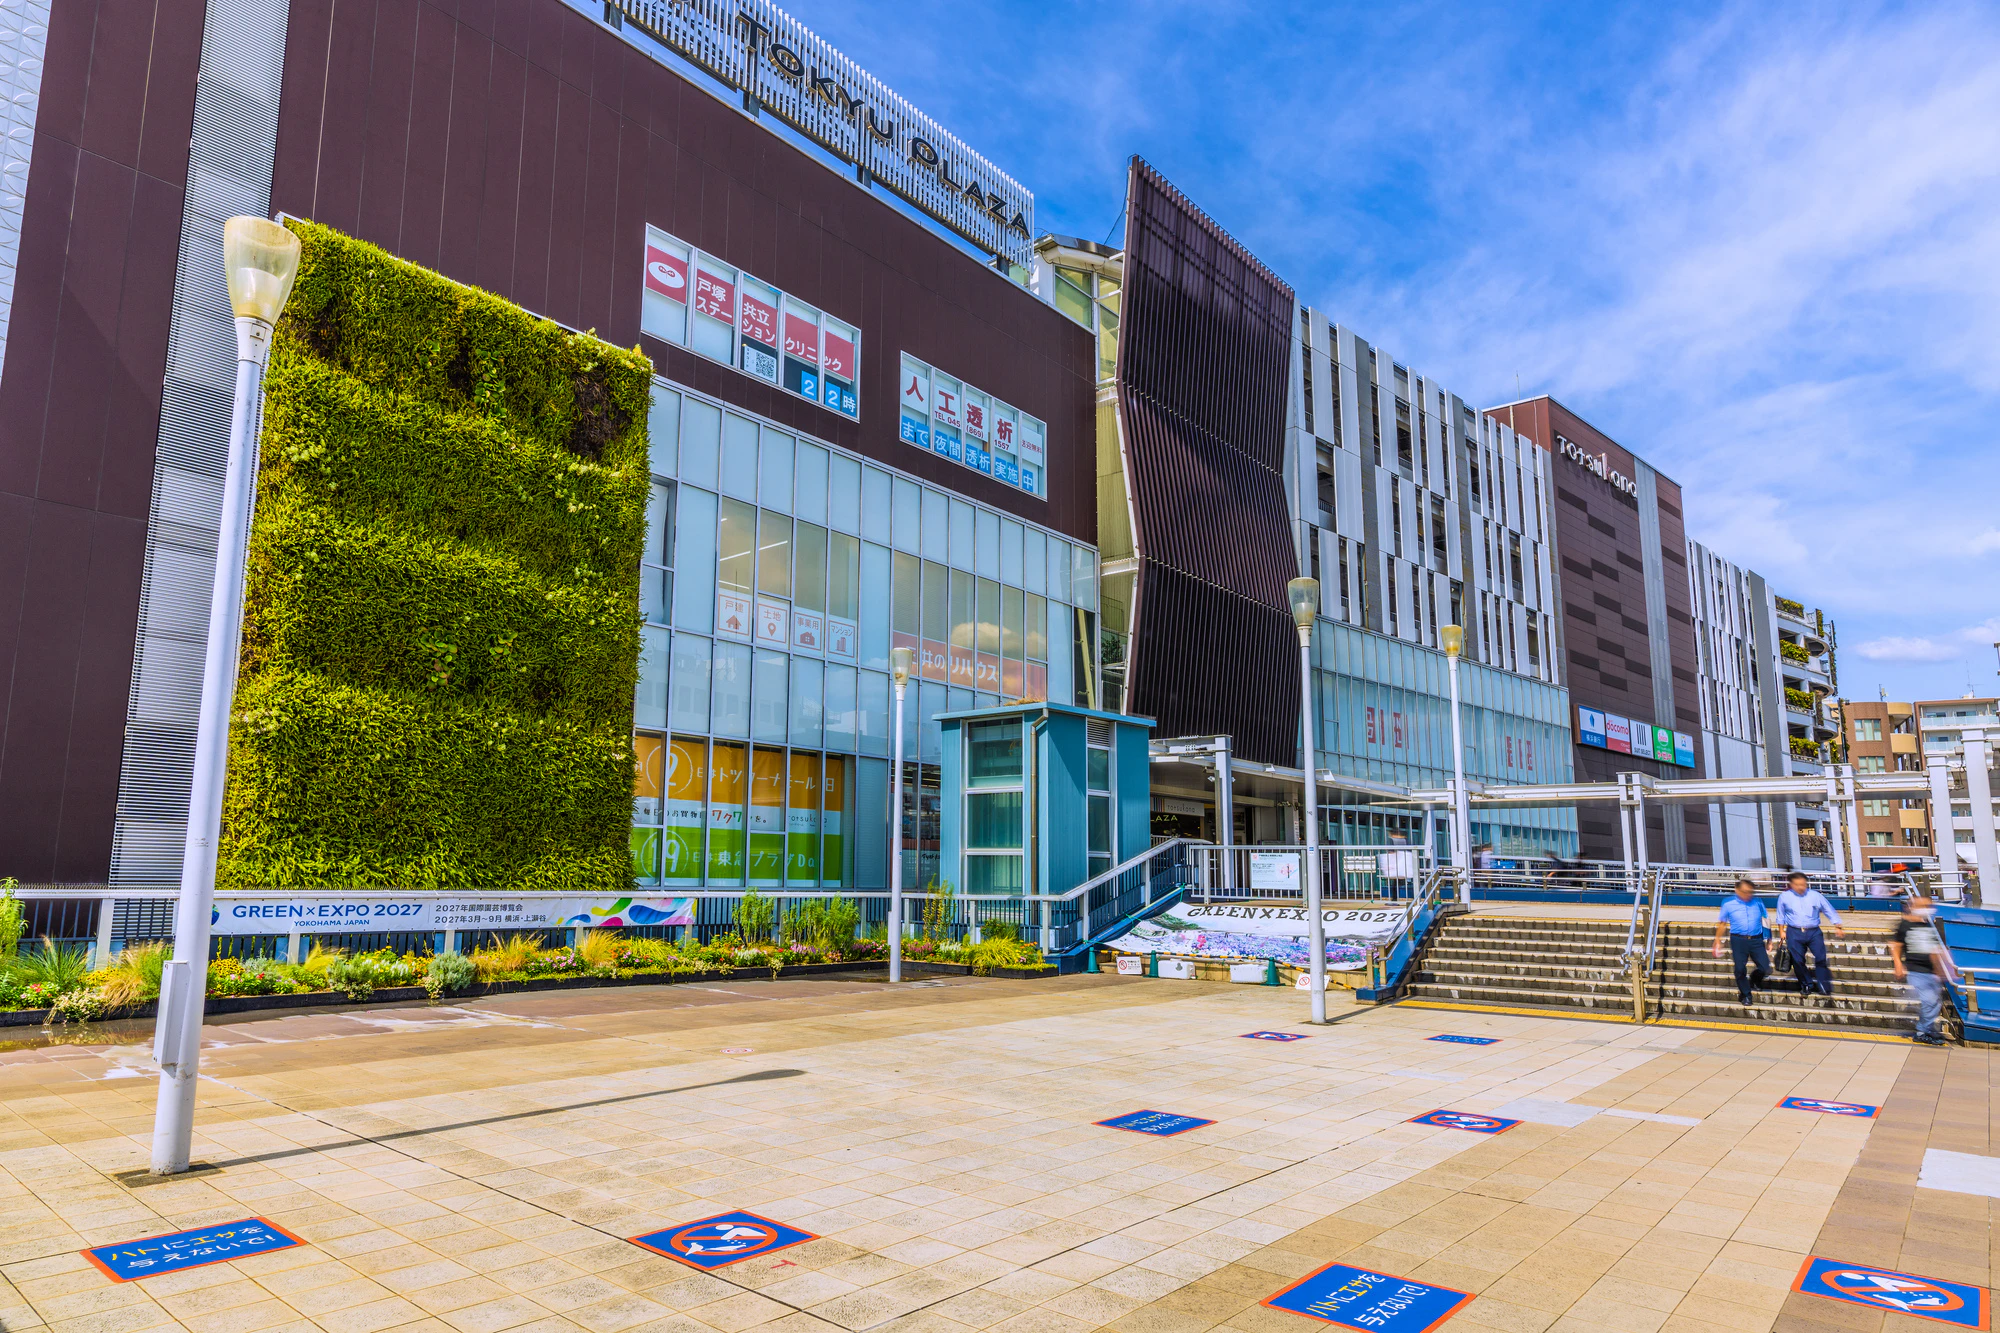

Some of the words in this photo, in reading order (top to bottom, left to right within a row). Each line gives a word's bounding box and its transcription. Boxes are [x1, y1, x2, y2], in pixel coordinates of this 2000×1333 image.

[737, 10, 894, 142] TOKYU
[908, 136, 1031, 239] PLAZA
[697, 276, 770, 327] 戸塚共立
[905, 375, 1013, 444] 人工透析
[934, 410, 945, 422] TEL
[947, 416, 961, 428] 045
[902, 421, 1034, 490] まで夜間透析実施中
[725, 599, 744, 614] 戸建
[763, 609, 782, 622] 土地
[797, 616, 819, 631] 事業用
[830, 625, 853, 637] マンション
[1606, 719, 1630, 736] docomo
[1150, 814, 1178, 822] AZA
[374, 904, 423, 916] 2027
[435, 904, 524, 912] 2027年国際園芸博覧会
[1187, 905, 1339, 922] GREEN×EXO
[1344, 911, 1402, 923] 2027
[294, 919, 342, 927] YOKOHAMA
[111, 1225, 265, 1261] ハトにエサを
[1305, 1273, 1386, 1317] ハトにエサを
